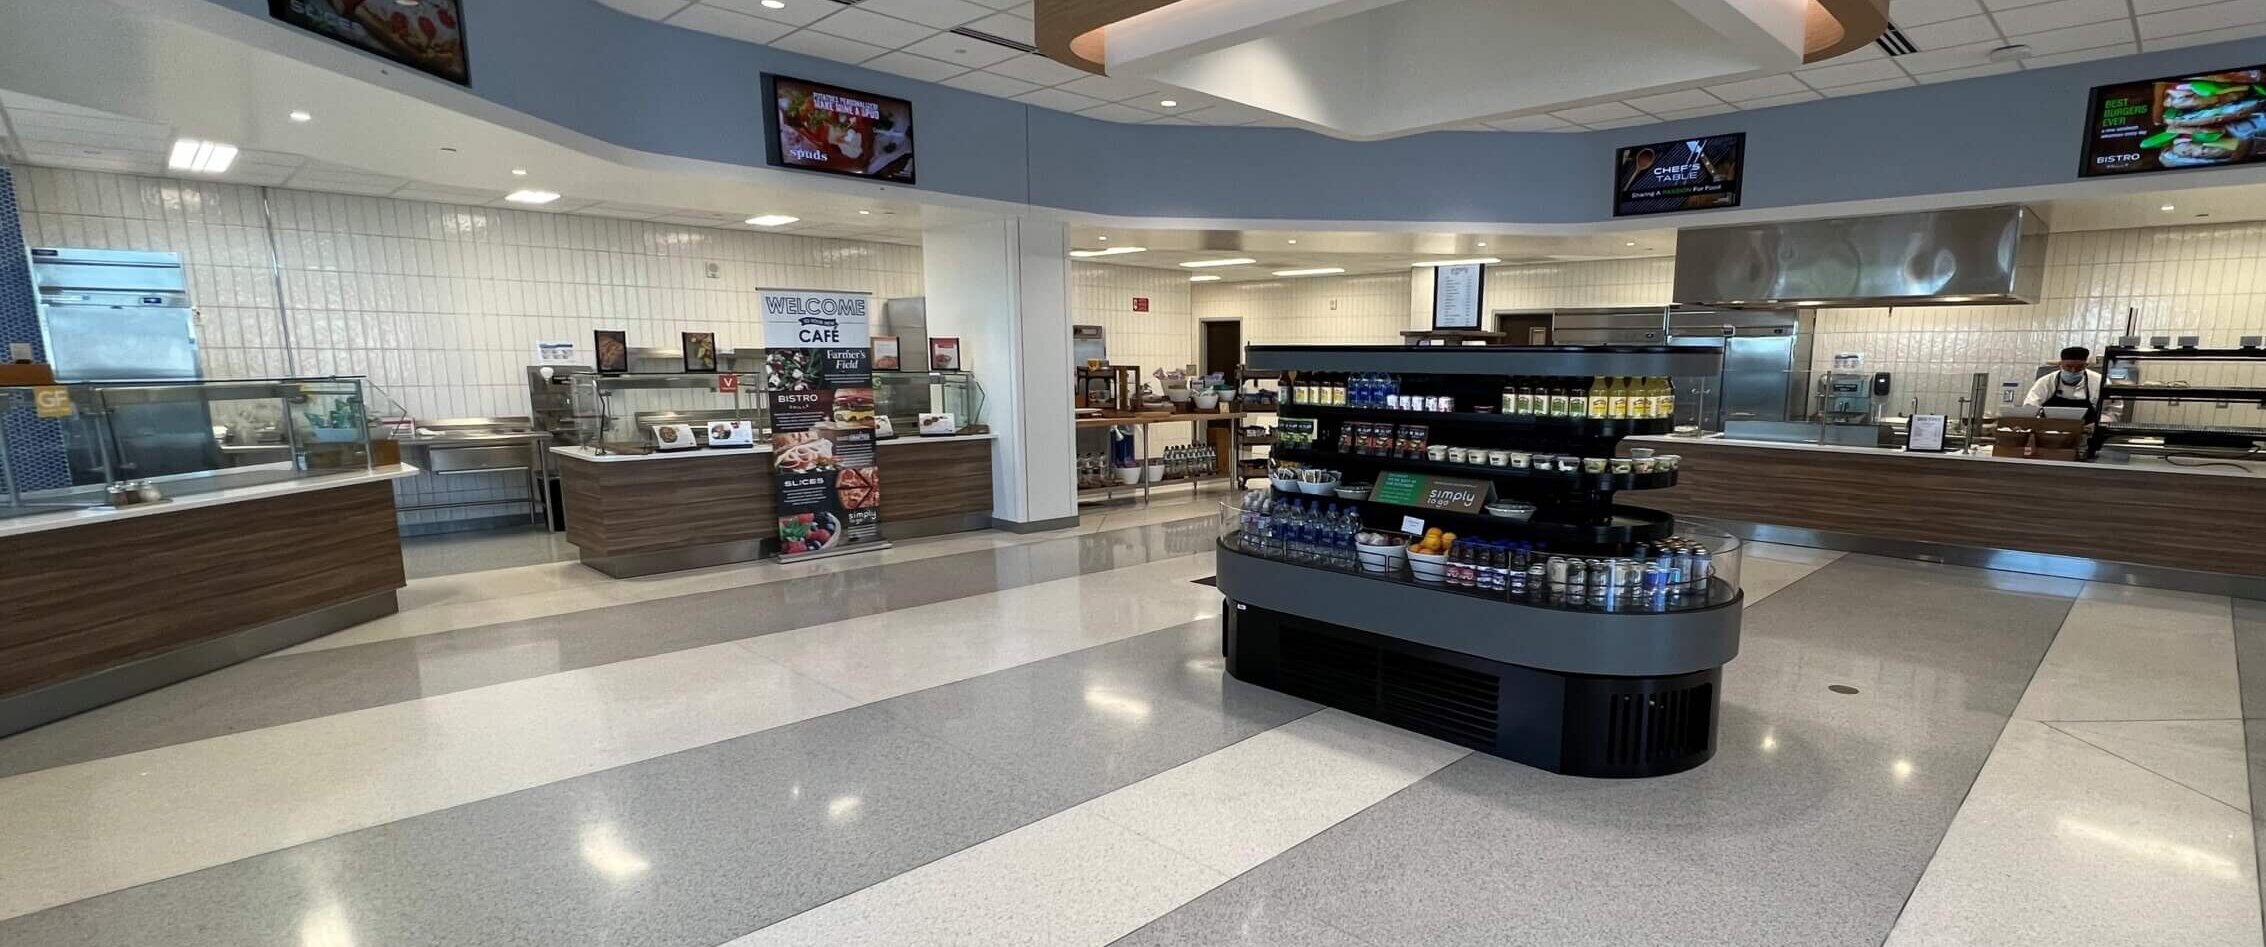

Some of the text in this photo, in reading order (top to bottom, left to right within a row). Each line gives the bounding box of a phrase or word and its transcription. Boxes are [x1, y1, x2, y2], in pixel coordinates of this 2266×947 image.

[2105, 98, 2128, 108] BEST
[2104, 105, 2148, 118] BURGERS
[789, 147, 828, 161] spuds
[2096, 153, 2141, 164] BISTRO
[1653, 163, 1701, 175] CHEF'S
[1656, 171, 1698, 182] TABLE
[765, 296, 866, 316] WELCOME
[798, 326, 840, 343] CAFÉ
[826, 349, 866, 360] Farmer's
[835, 359, 859, 369] Field
[723, 377, 733, 387] V
[38, 390, 67, 408] GF
[777, 393, 818, 403] BISTRO
[783, 477, 825, 487] SLICES
[1429, 489, 1475, 507] simply
[1436, 500, 1449, 508] go
[848, 510, 877, 520] simply
